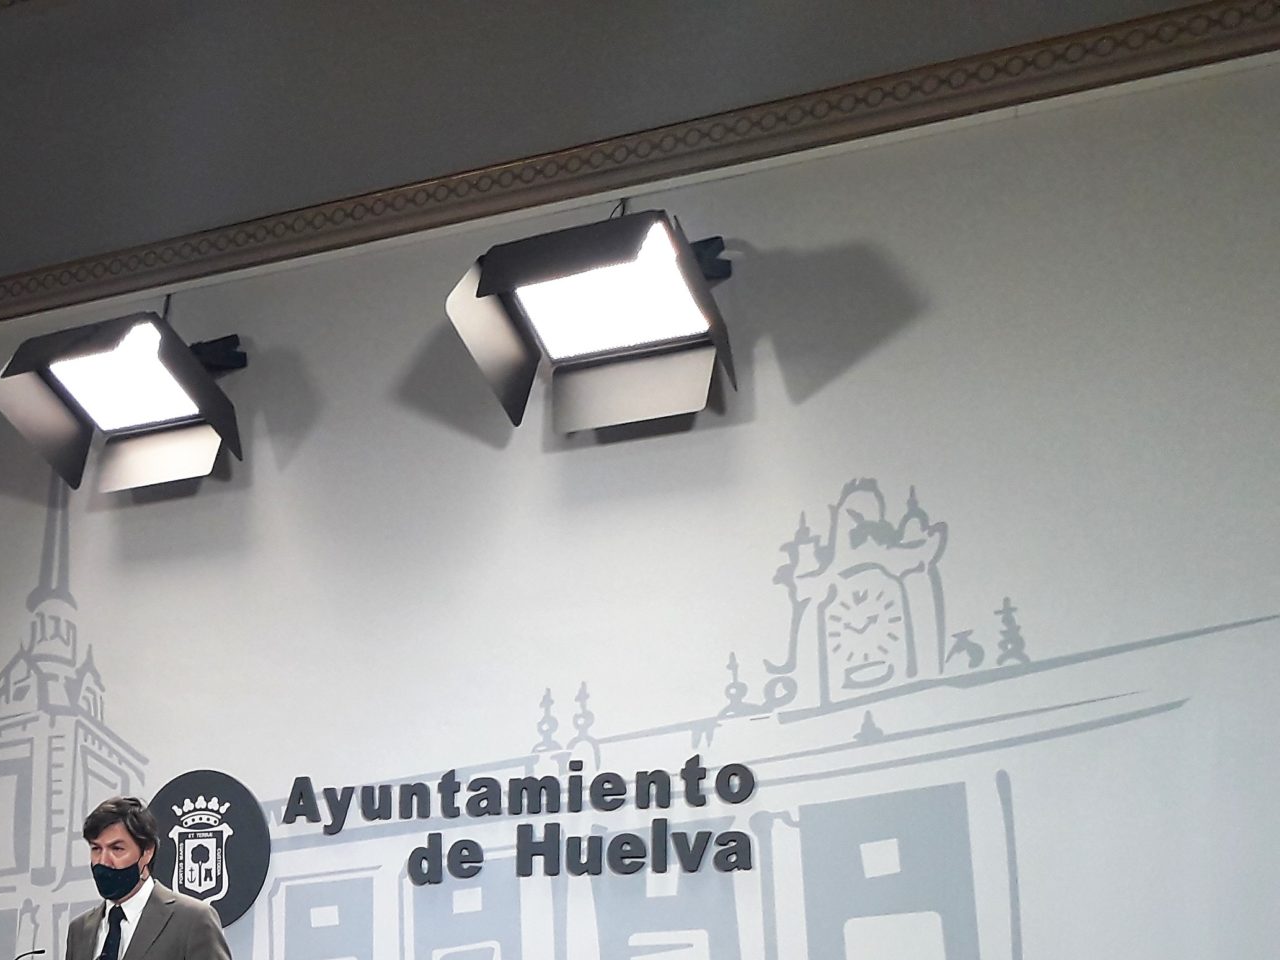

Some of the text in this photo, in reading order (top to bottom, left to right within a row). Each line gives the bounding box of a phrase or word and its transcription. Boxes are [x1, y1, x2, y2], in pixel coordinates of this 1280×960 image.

[282, 754, 755, 835] Ayuntamiento
[406, 818, 754, 886] de Huelva
